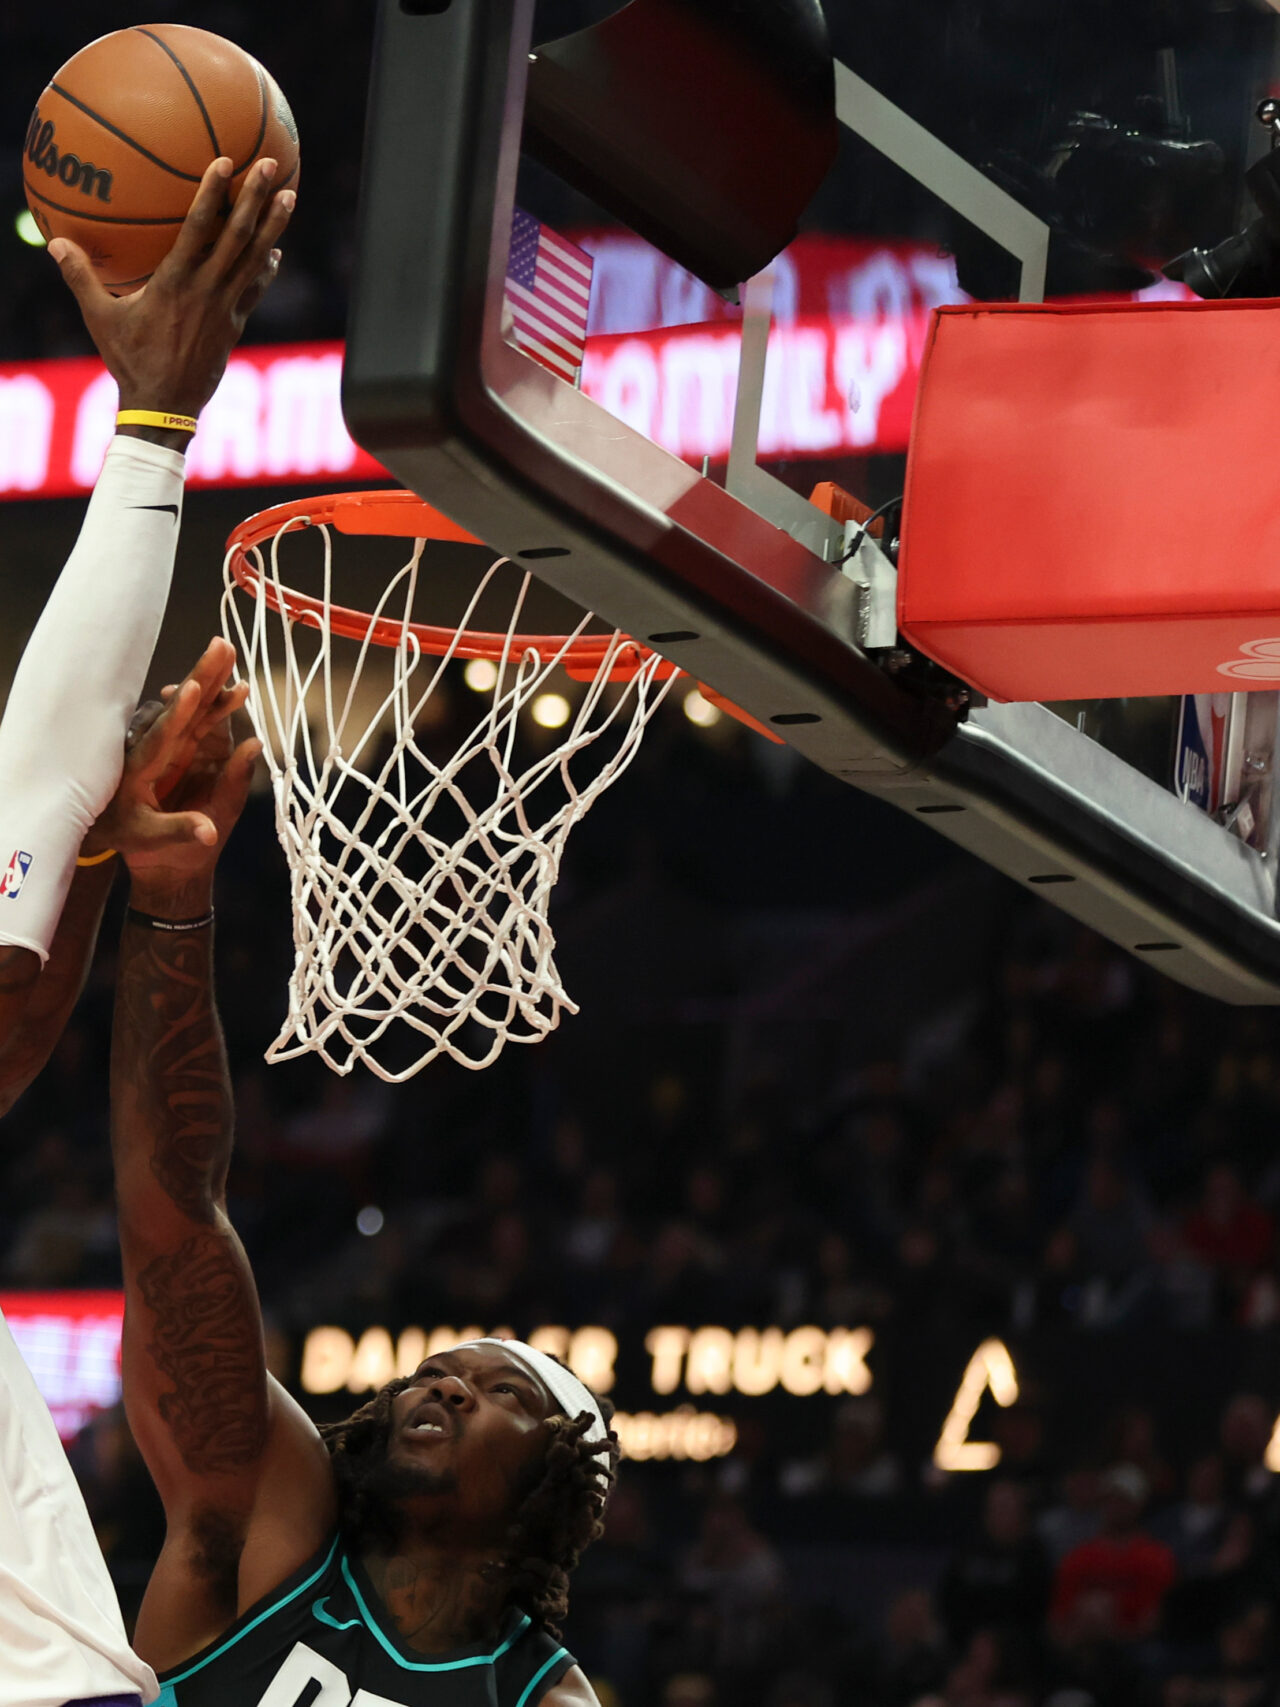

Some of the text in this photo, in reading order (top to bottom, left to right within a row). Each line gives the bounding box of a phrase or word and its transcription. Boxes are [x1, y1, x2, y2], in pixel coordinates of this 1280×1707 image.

[70, 353, 356, 488] FRM
[582, 326, 907, 457] AMILY
[1182, 746, 1204, 796] NBA
[301, 1325, 875, 1396] DAIER TRUCK
